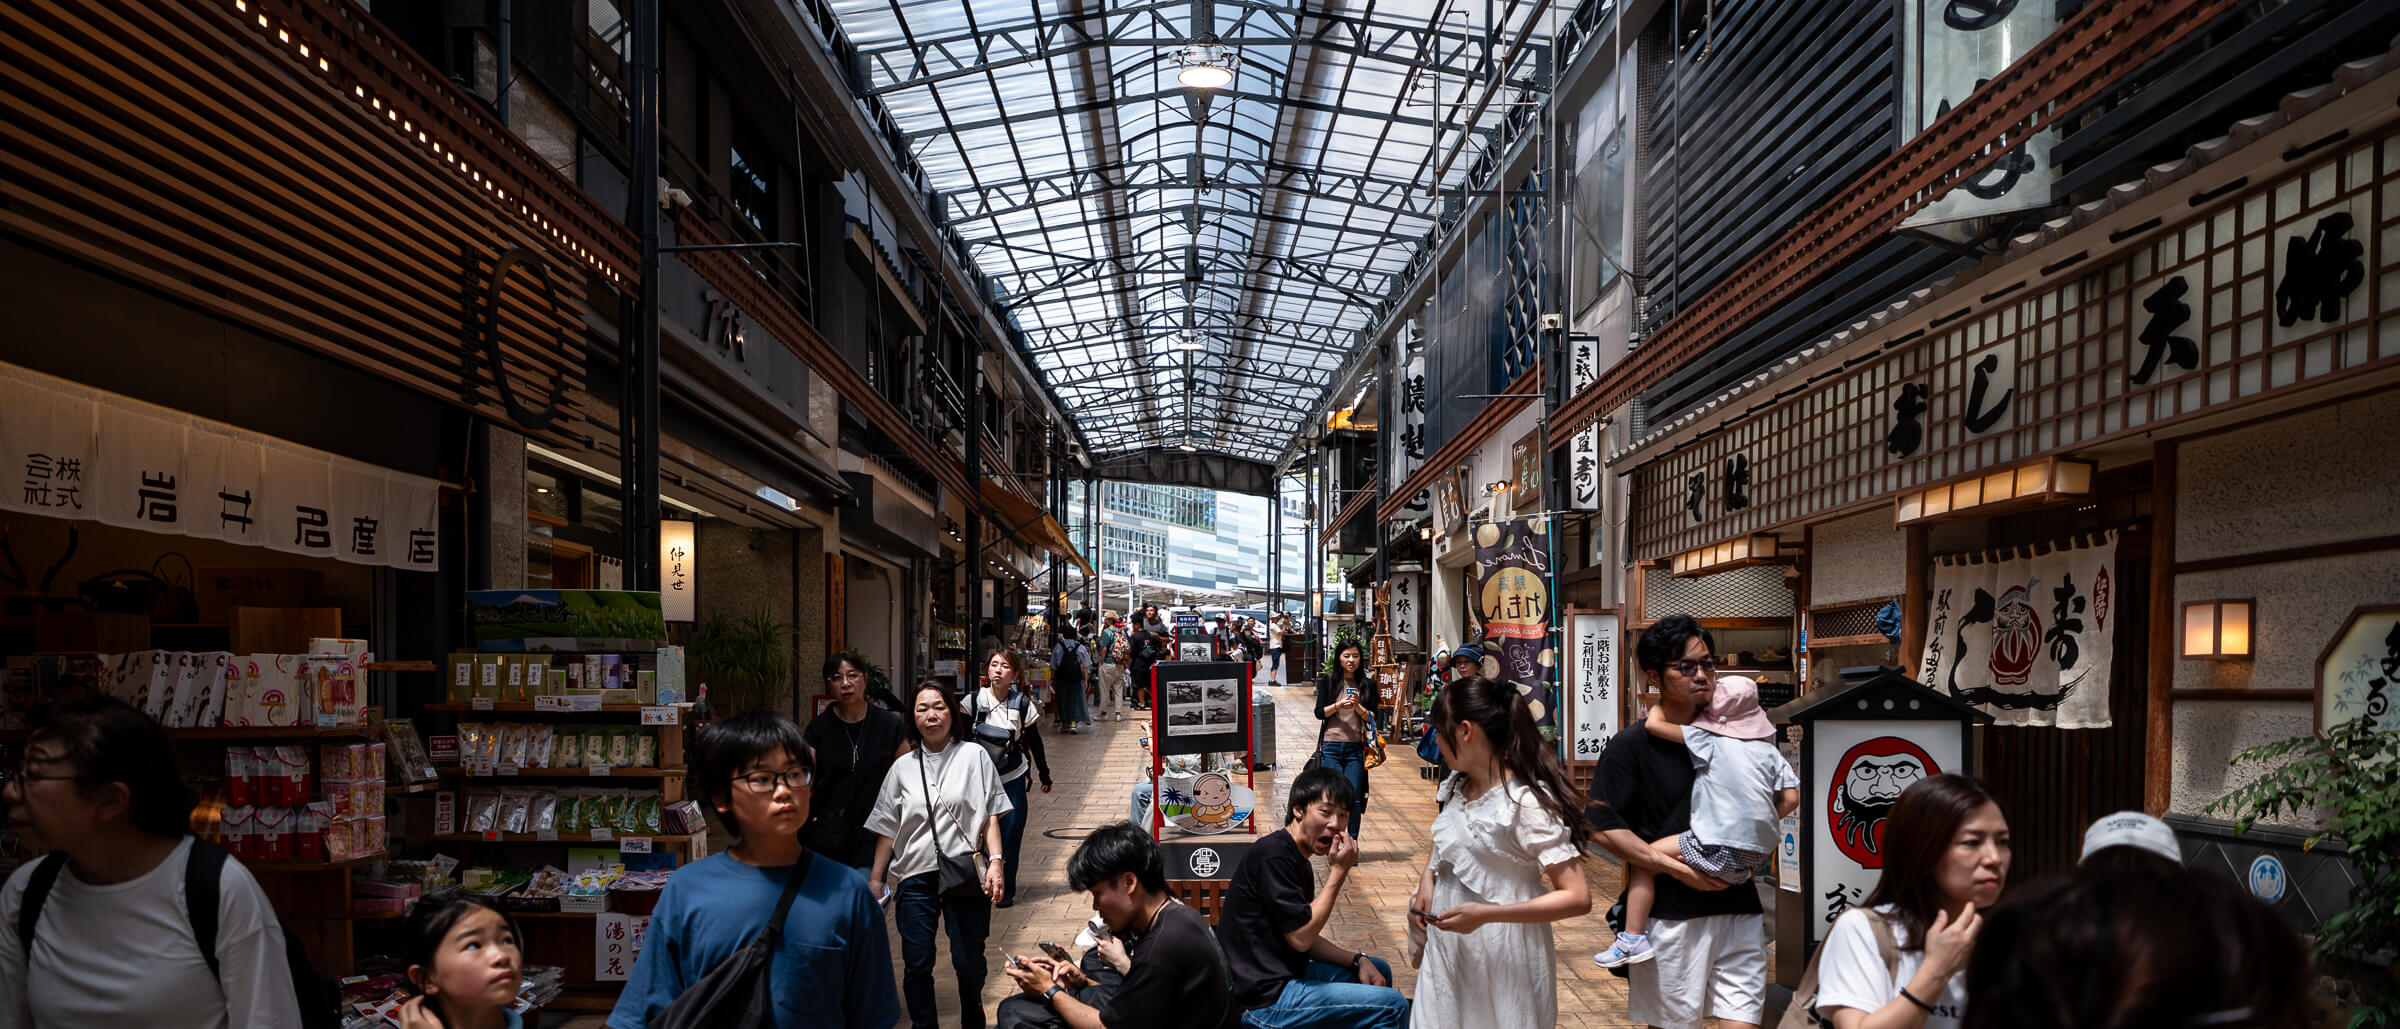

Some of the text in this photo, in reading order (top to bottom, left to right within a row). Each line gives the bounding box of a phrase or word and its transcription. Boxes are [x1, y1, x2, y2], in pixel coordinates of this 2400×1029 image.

[670, 546, 684, 590] 仲見世
[1582, 633, 1594, 704] ご利用下さい
[1597, 628, 1609, 700] 二階お座敷を
[605, 921, 625, 976] 湯の花
